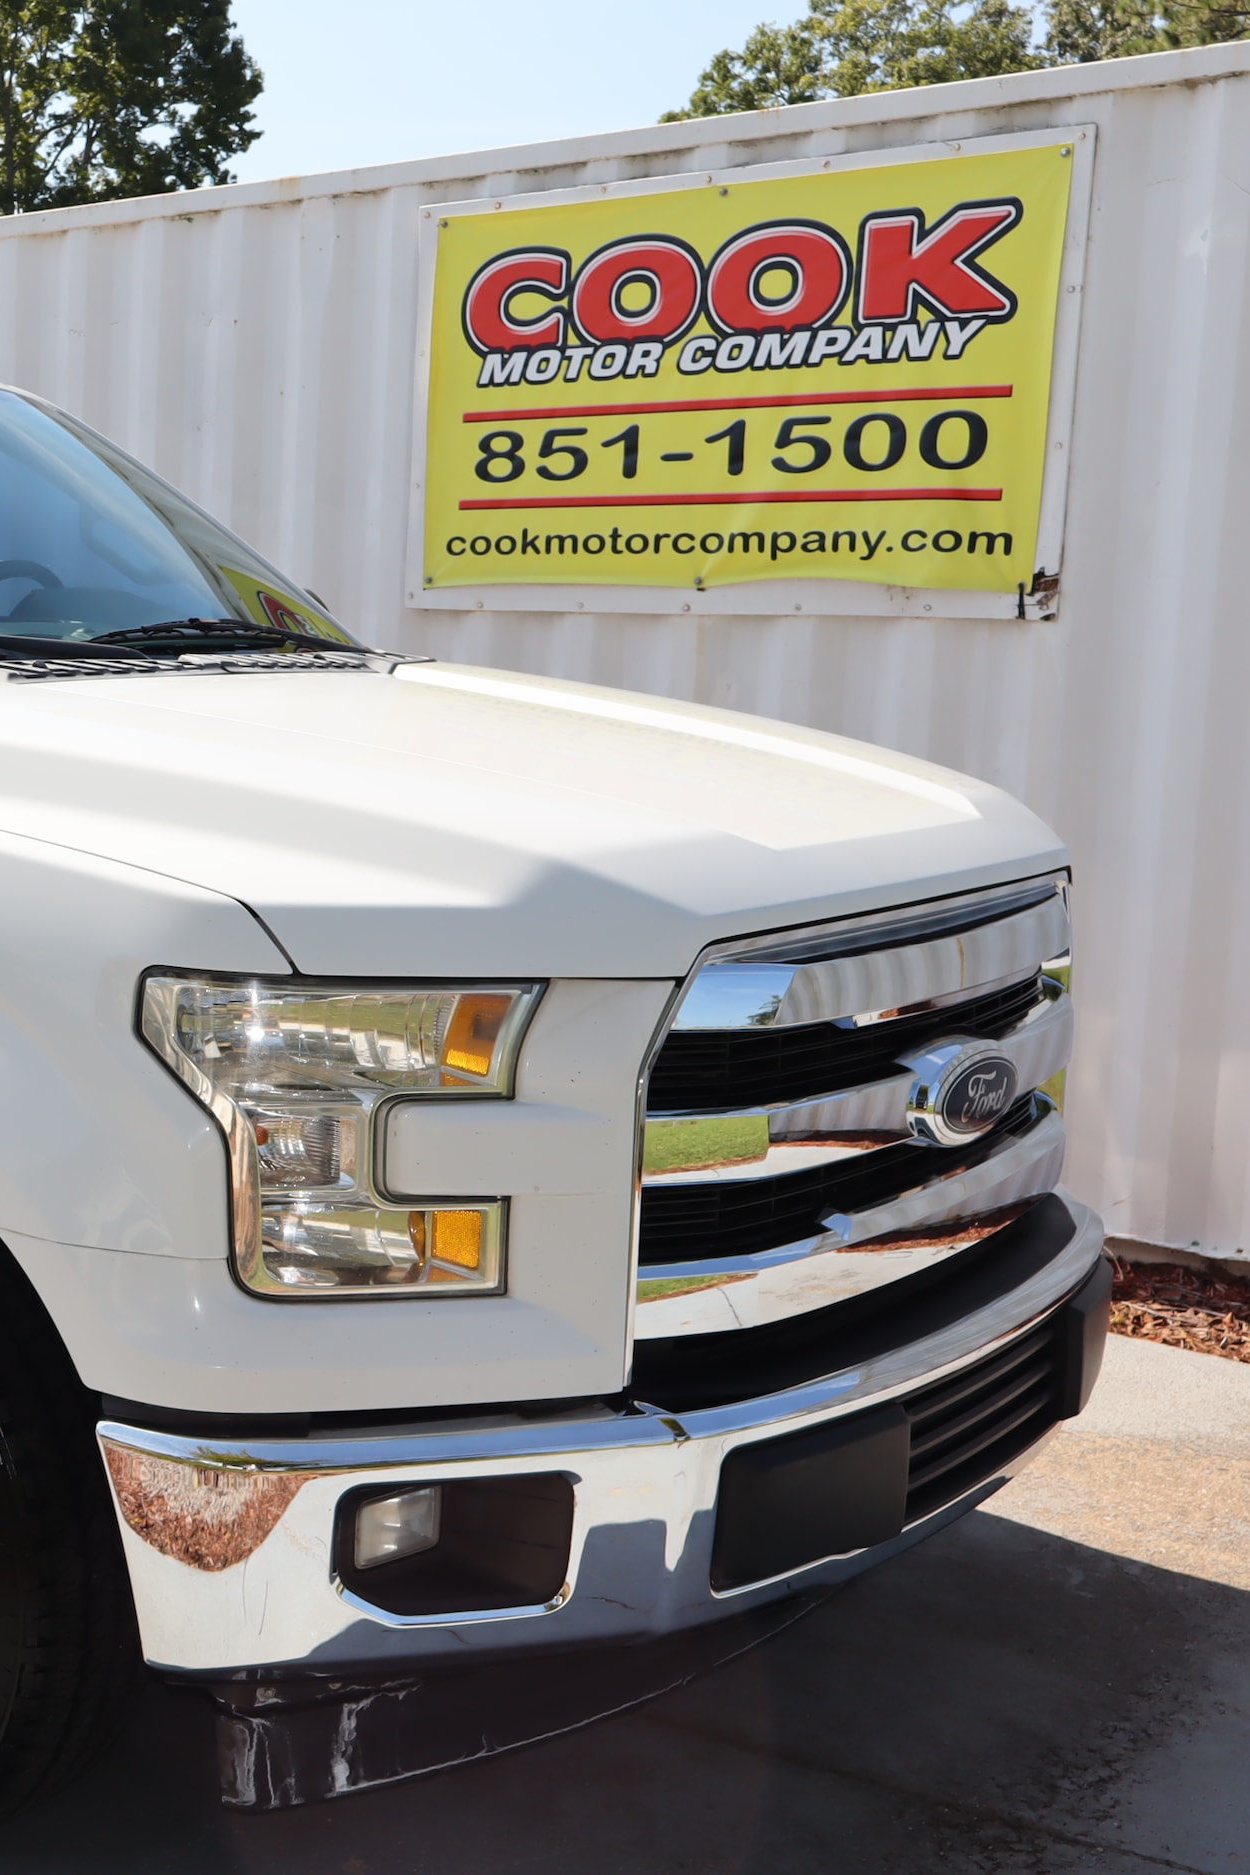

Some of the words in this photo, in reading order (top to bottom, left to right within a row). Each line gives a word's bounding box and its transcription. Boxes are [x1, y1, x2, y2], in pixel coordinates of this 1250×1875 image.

[462, 197, 1023, 352] COOK
[477, 341, 663, 387] MOTOR
[677, 319, 987, 375] COMPANY
[474, 410, 988, 483] 851-1500
[446, 527, 1014, 561] cookmotorcompany.com
[961, 1070, 1008, 1123] Ford
